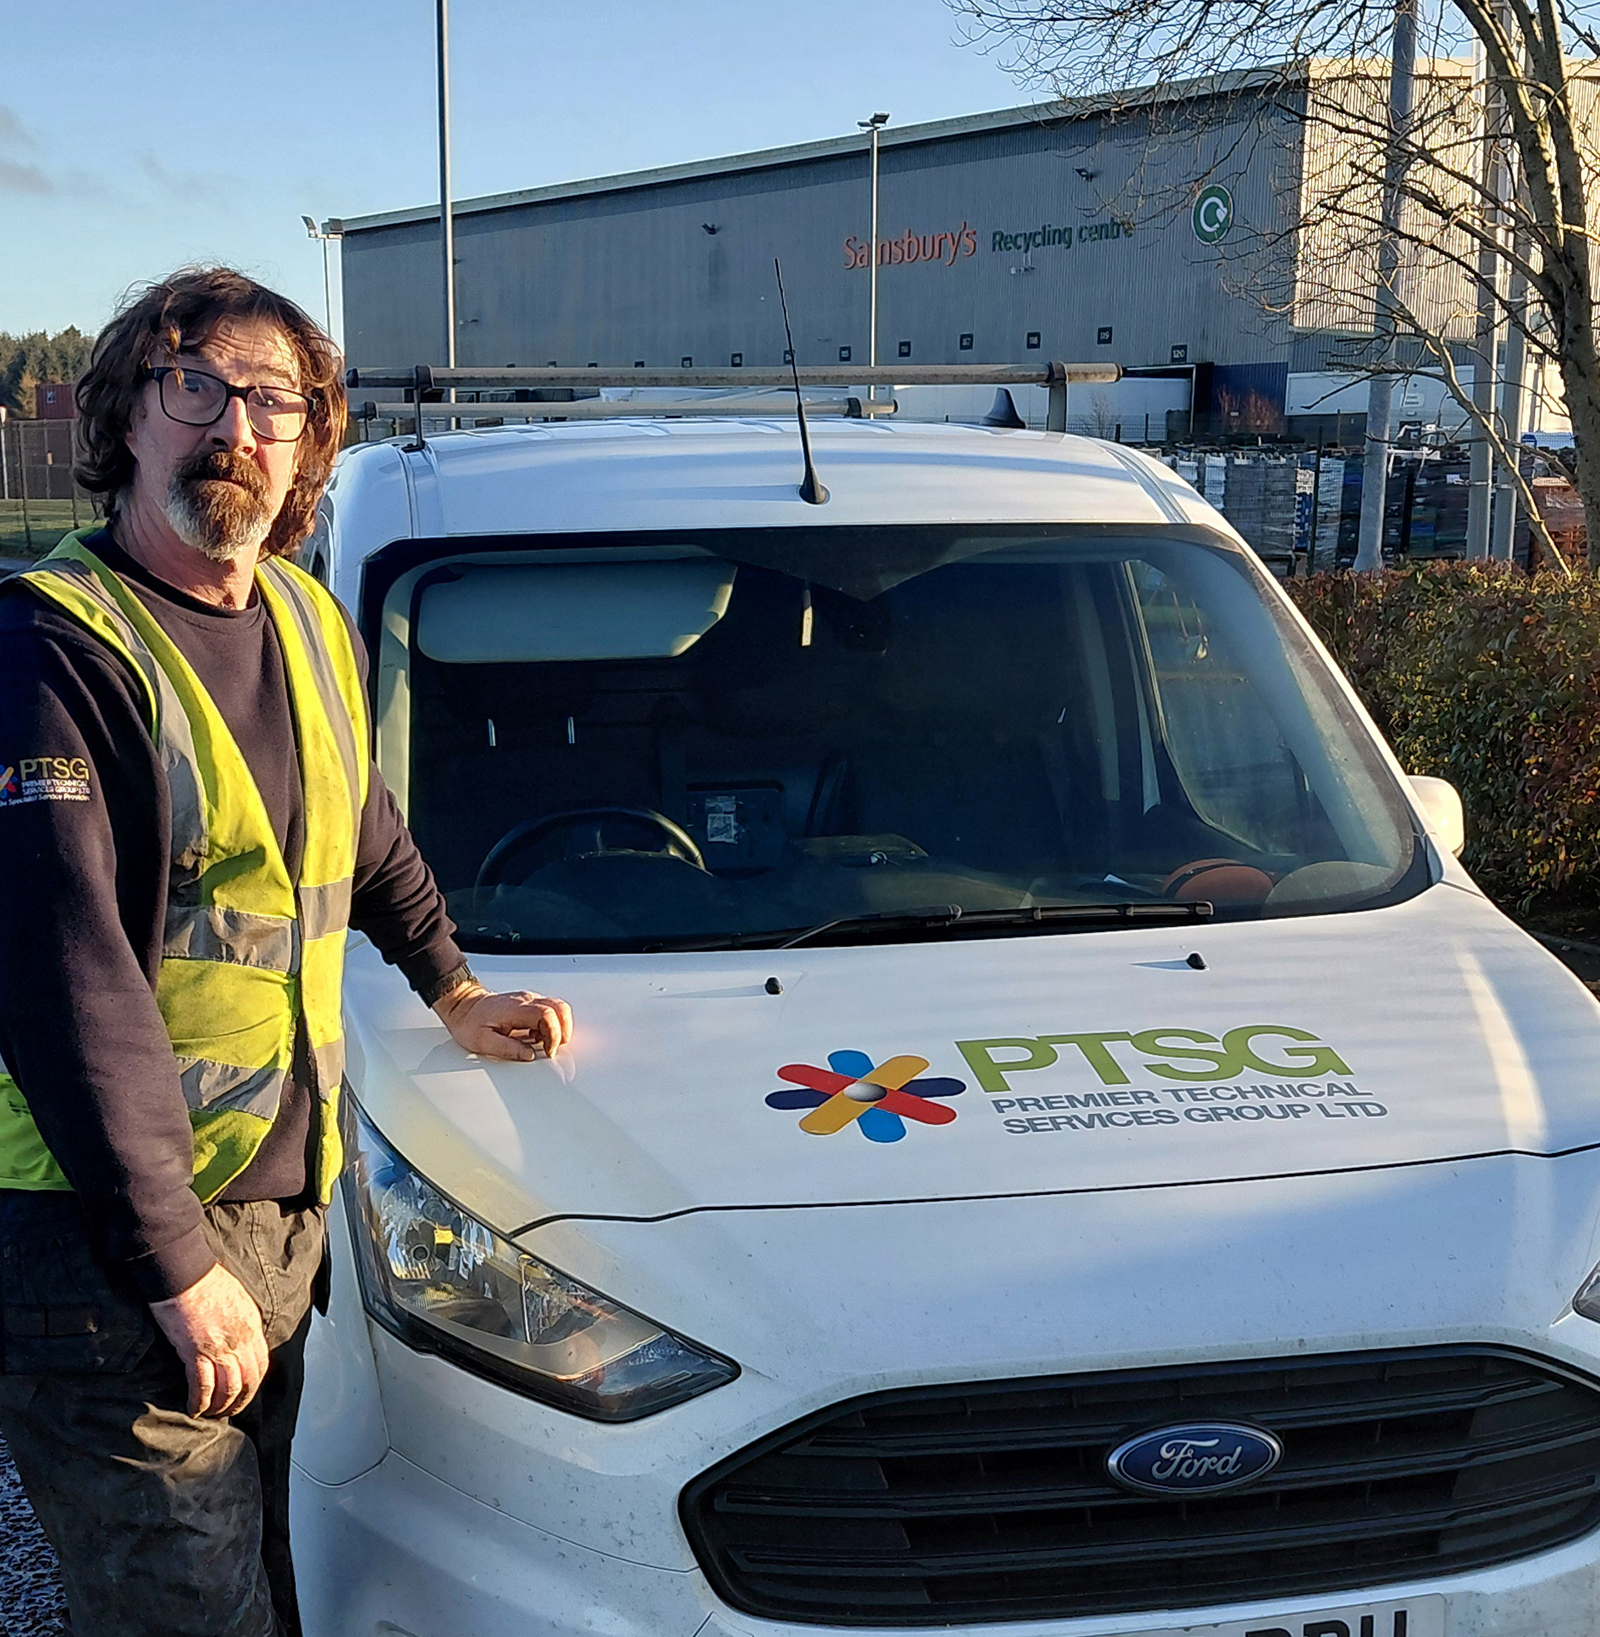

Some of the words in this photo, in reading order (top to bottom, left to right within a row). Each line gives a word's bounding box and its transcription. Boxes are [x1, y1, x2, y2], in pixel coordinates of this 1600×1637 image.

[843, 221, 977, 269] Sansbury's
[992, 223, 1072, 253] Recycling
[1173, 348, 1186, 358] 120
[20, 757, 89, 780] PTSG
[955, 1025, 1354, 1093] PTSG
[991, 1089, 1157, 1114] PREMIER
[1161, 1081, 1373, 1104] TECHNICAL
[1003, 1108, 1180, 1135] SERVICES
[1184, 1102, 1311, 1123] GROUP
[1314, 1100, 1388, 1119] LTD
[1151, 1438, 1242, 1480] Ford
